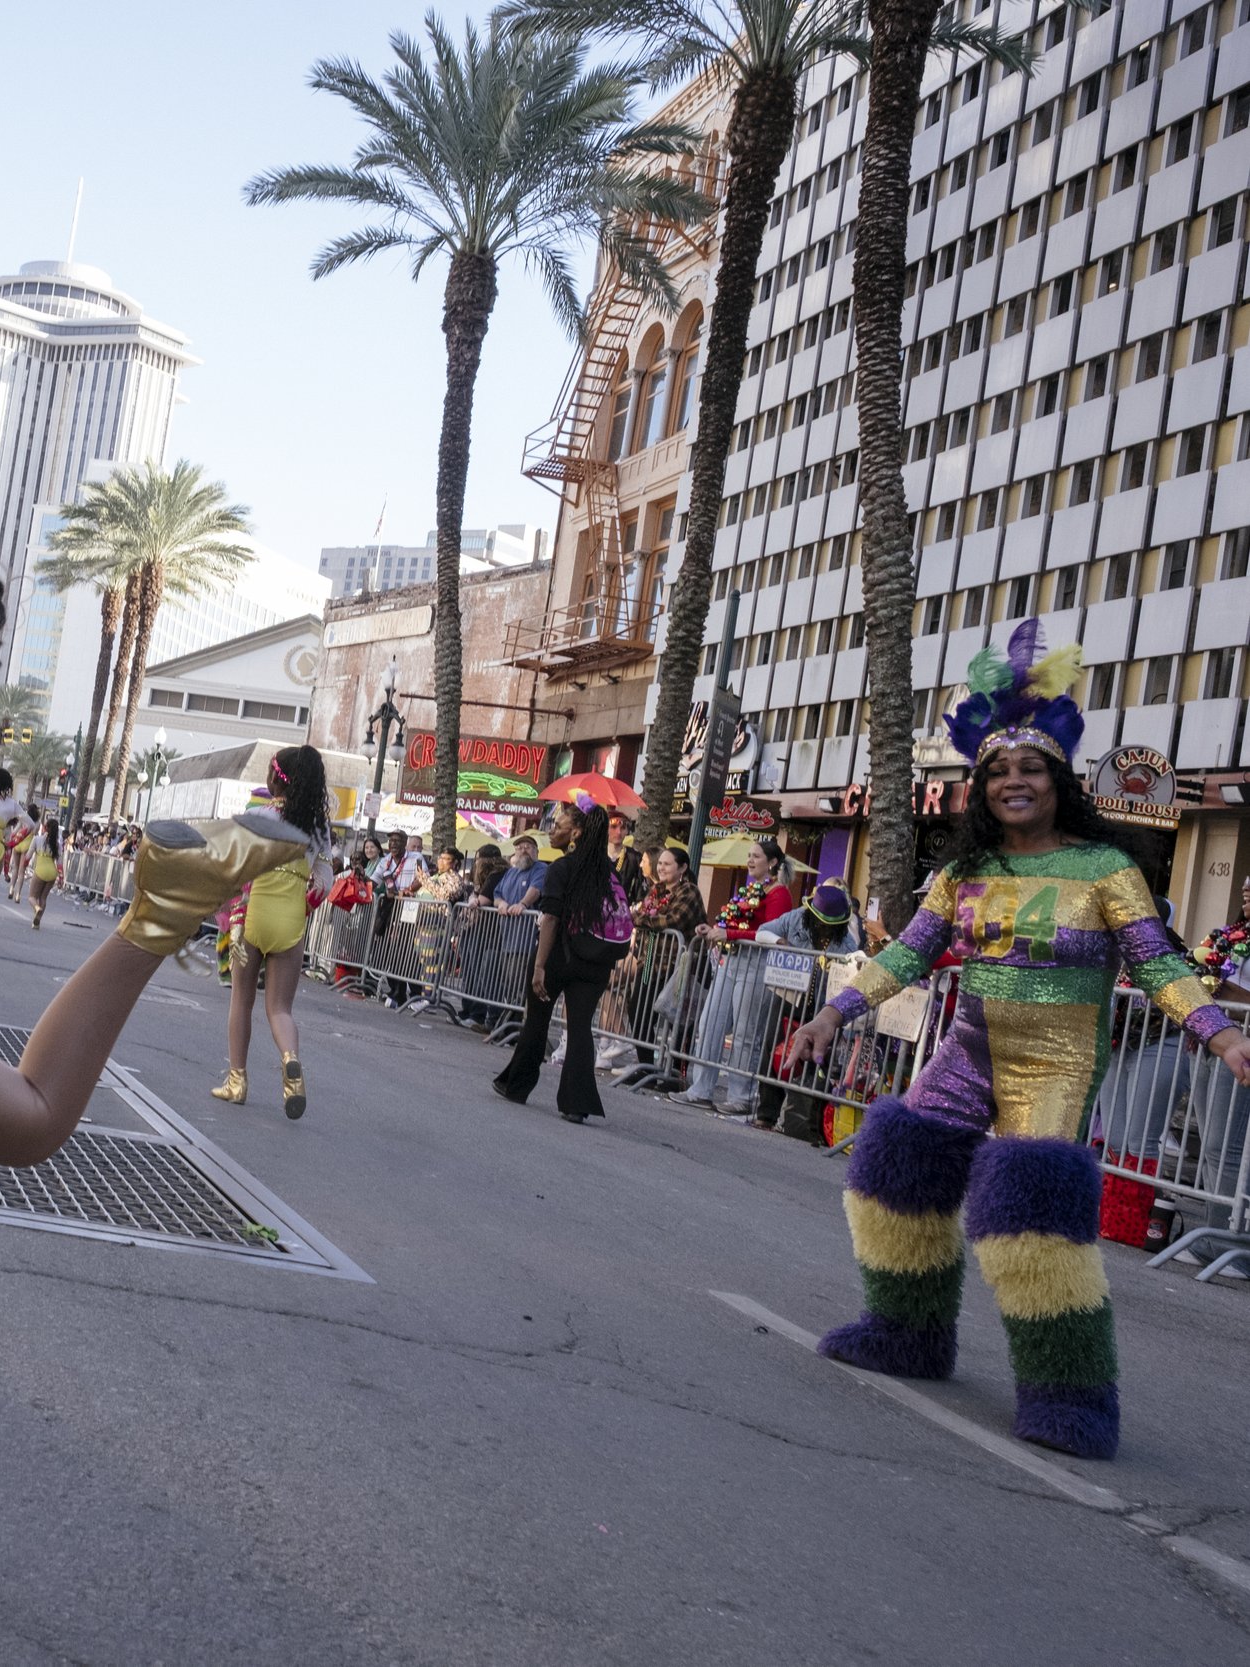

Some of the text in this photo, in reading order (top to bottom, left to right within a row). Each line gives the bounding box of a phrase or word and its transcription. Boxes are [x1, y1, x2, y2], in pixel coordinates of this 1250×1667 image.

[410, 733, 547, 784] CRWDADDY
[1116, 750, 1173, 777] CAJUN
[403, 792, 541, 815] MAGNO RALINE COMPANY
[709, 796, 775, 828] Willie's
[1095, 795, 1182, 819] BOIL HOUSE
[1126, 815, 1154, 824] KITCHEN
[1208, 862, 1230, 877] 438
[951, 883, 1059, 961] 504
